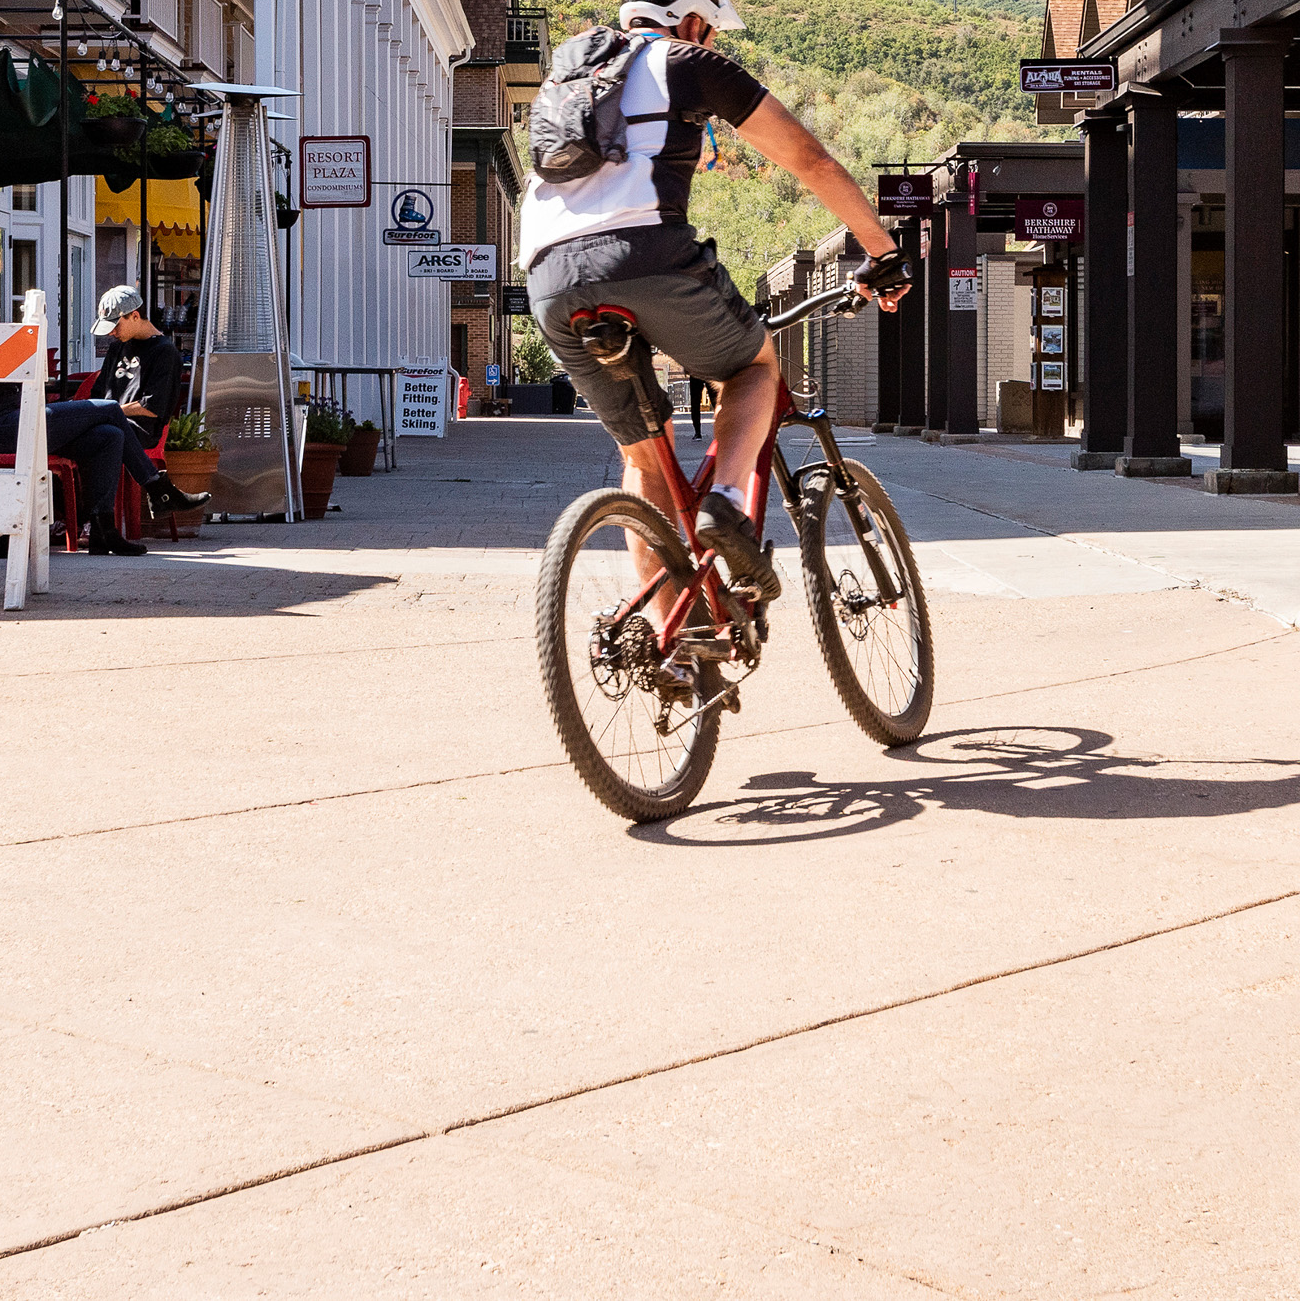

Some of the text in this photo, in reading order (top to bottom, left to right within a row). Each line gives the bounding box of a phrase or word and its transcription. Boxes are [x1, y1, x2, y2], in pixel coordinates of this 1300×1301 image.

[307, 152, 363, 163] RESORT
[313, 167, 357, 179] PLAZA
[387, 231, 436, 239] Surefoot
[1026, 226, 1074, 234] HATHAWAY
[419, 255, 462, 266] ARCS
[405, 382, 438, 392] Better
[402, 394, 441, 406] Fitting.
[403, 408, 437, 418] Better
[402, 419, 440, 431] Skiing.
